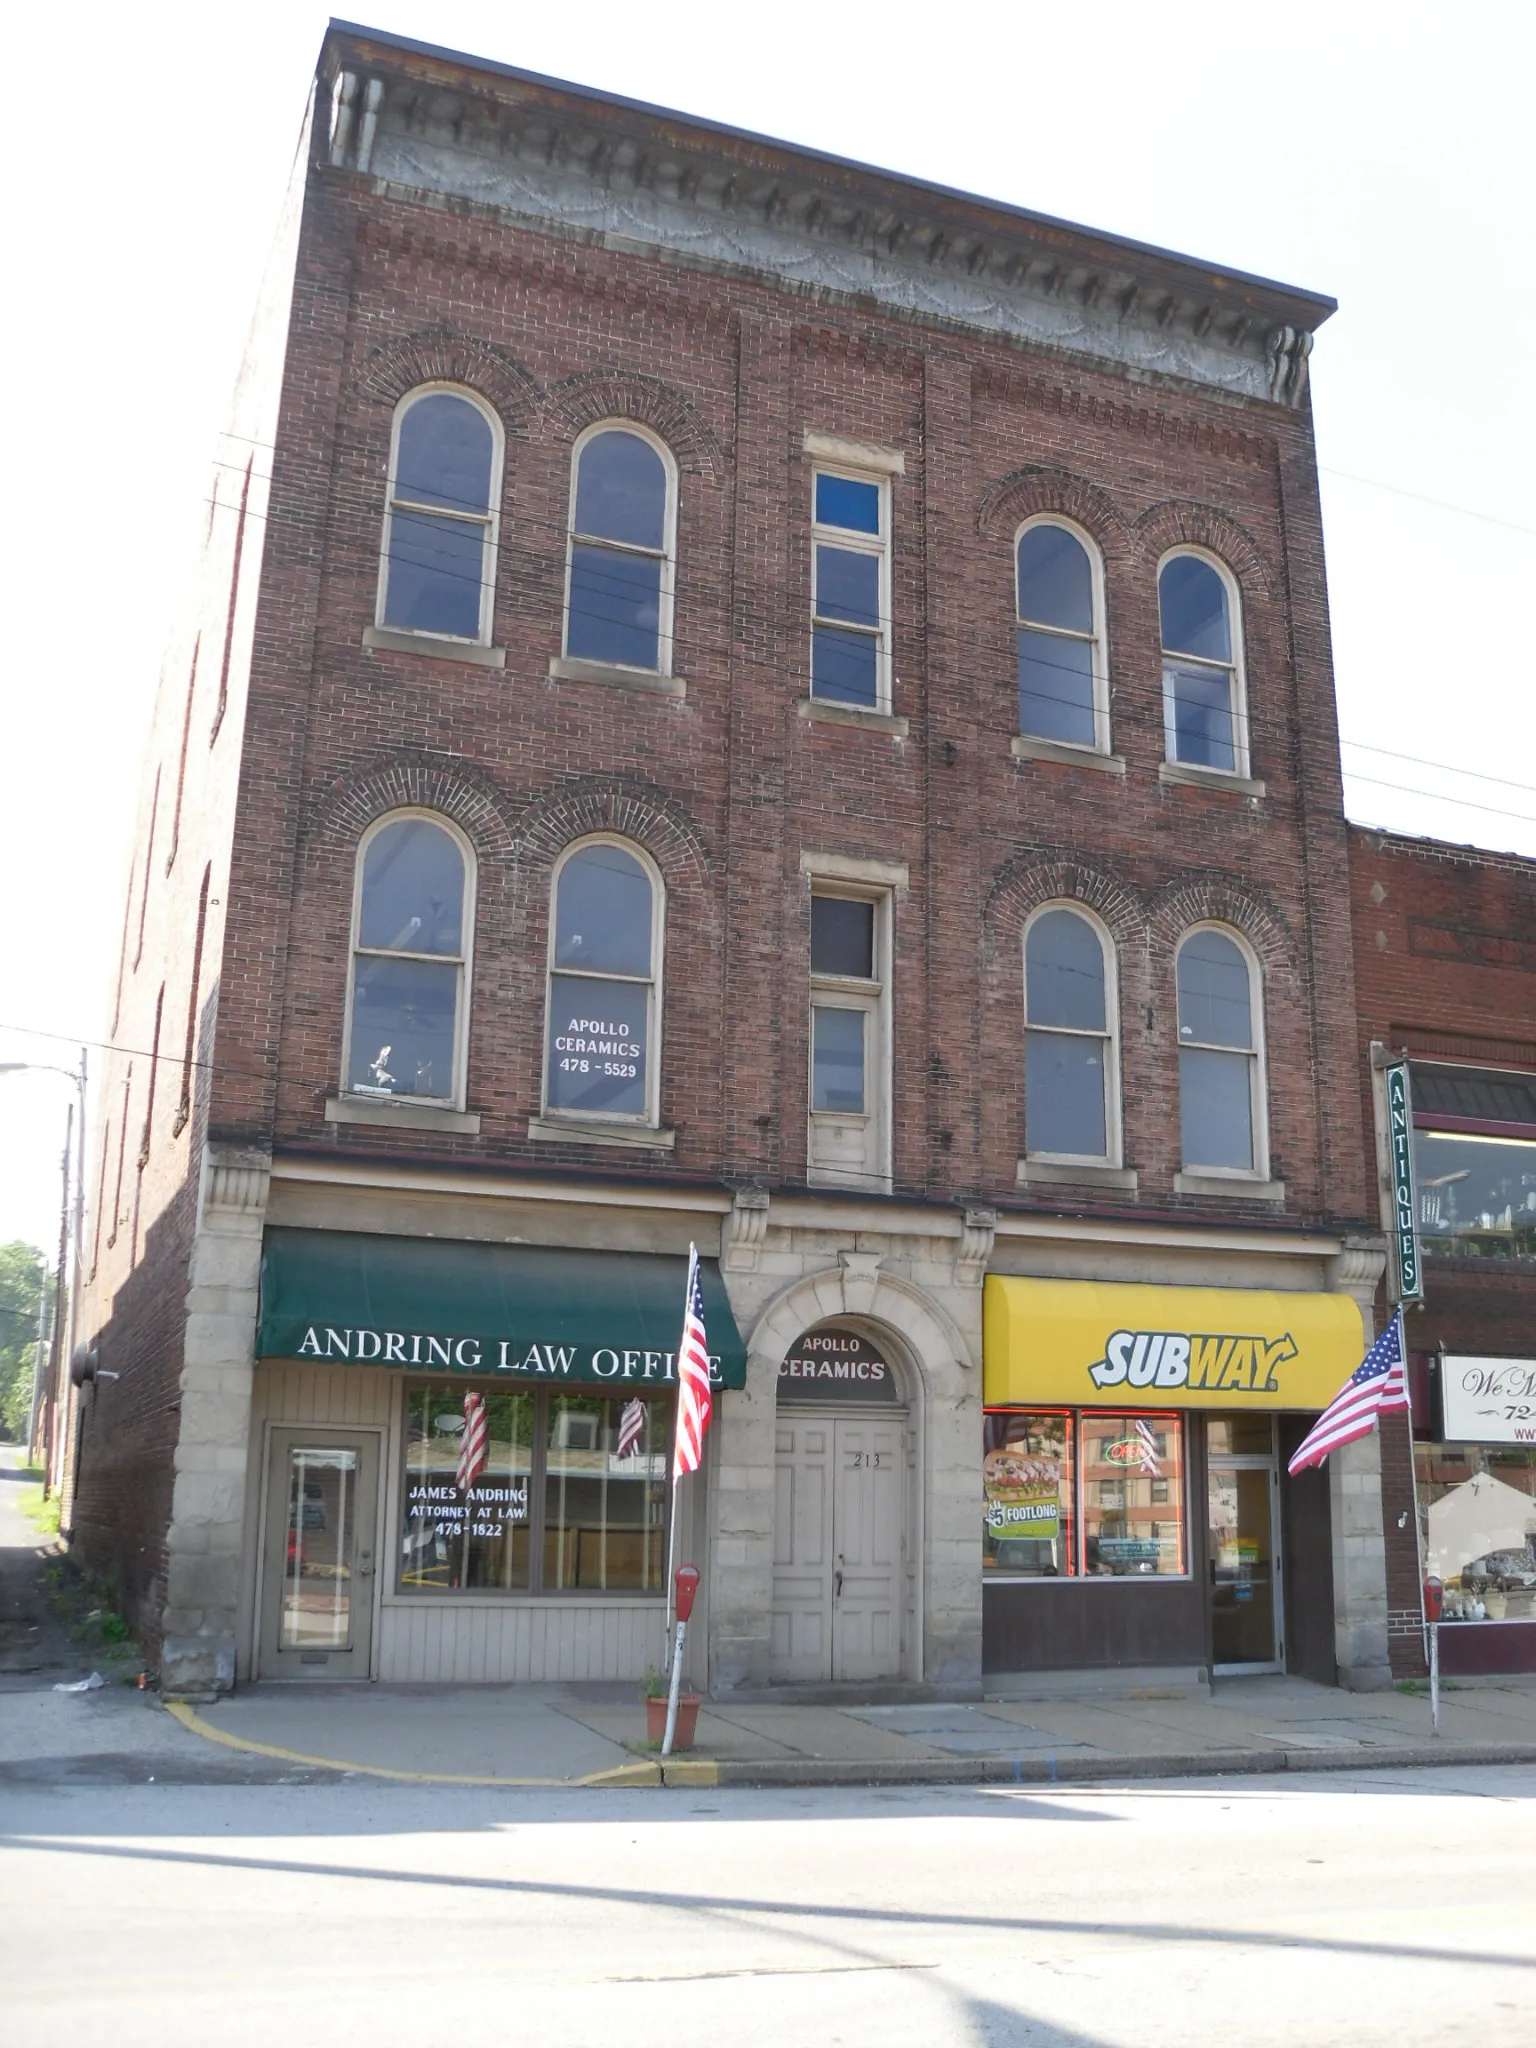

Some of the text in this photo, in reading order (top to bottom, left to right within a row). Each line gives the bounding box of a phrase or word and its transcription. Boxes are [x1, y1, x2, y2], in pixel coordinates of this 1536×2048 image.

[568, 1019, 629, 1036] APOLLO
[555, 1037, 640, 1057] CERAMICS
[1392, 1085, 1415, 1280] ANTIQUES
[802, 1337, 860, 1352] APOLLO
[297, 1326, 723, 1382] ANDRING LAW OFFIE
[1088, 1329, 1298, 1392] SUBWAY
[779, 1359, 885, 1380] CERAMICS
[1514, 1428, 1536, 1440] WW
[854, 1453, 880, 1467] 213
[409, 1486, 528, 1503] JAMES ANDRING
[410, 1505, 525, 1519] ATTORNEY AT LAW
[1007, 1504, 1057, 1521] FOOTLONG
